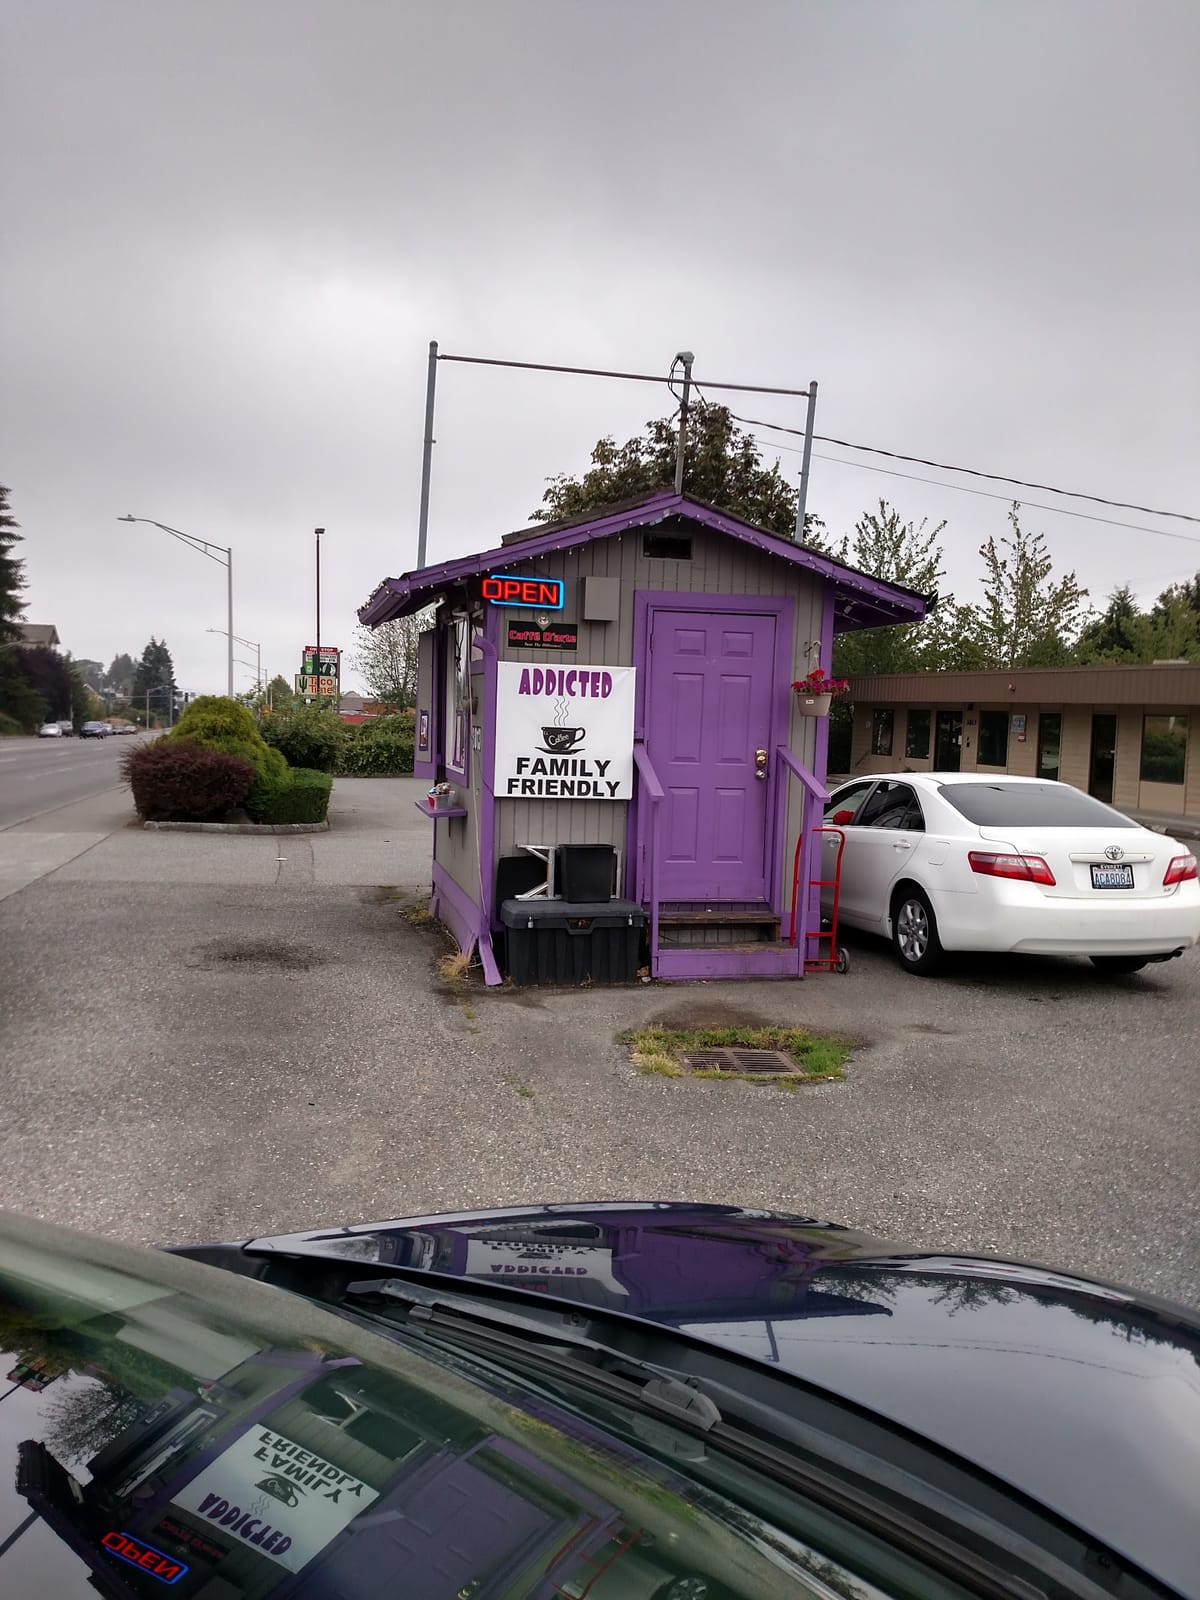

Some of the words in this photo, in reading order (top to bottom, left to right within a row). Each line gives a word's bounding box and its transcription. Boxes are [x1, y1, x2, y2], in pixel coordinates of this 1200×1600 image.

[482, 579, 558, 604] OPEN
[518, 668, 613, 699] ADDICTED
[516, 757, 612, 778] FAMILY
[507, 778, 621, 798] FRIENDLY
